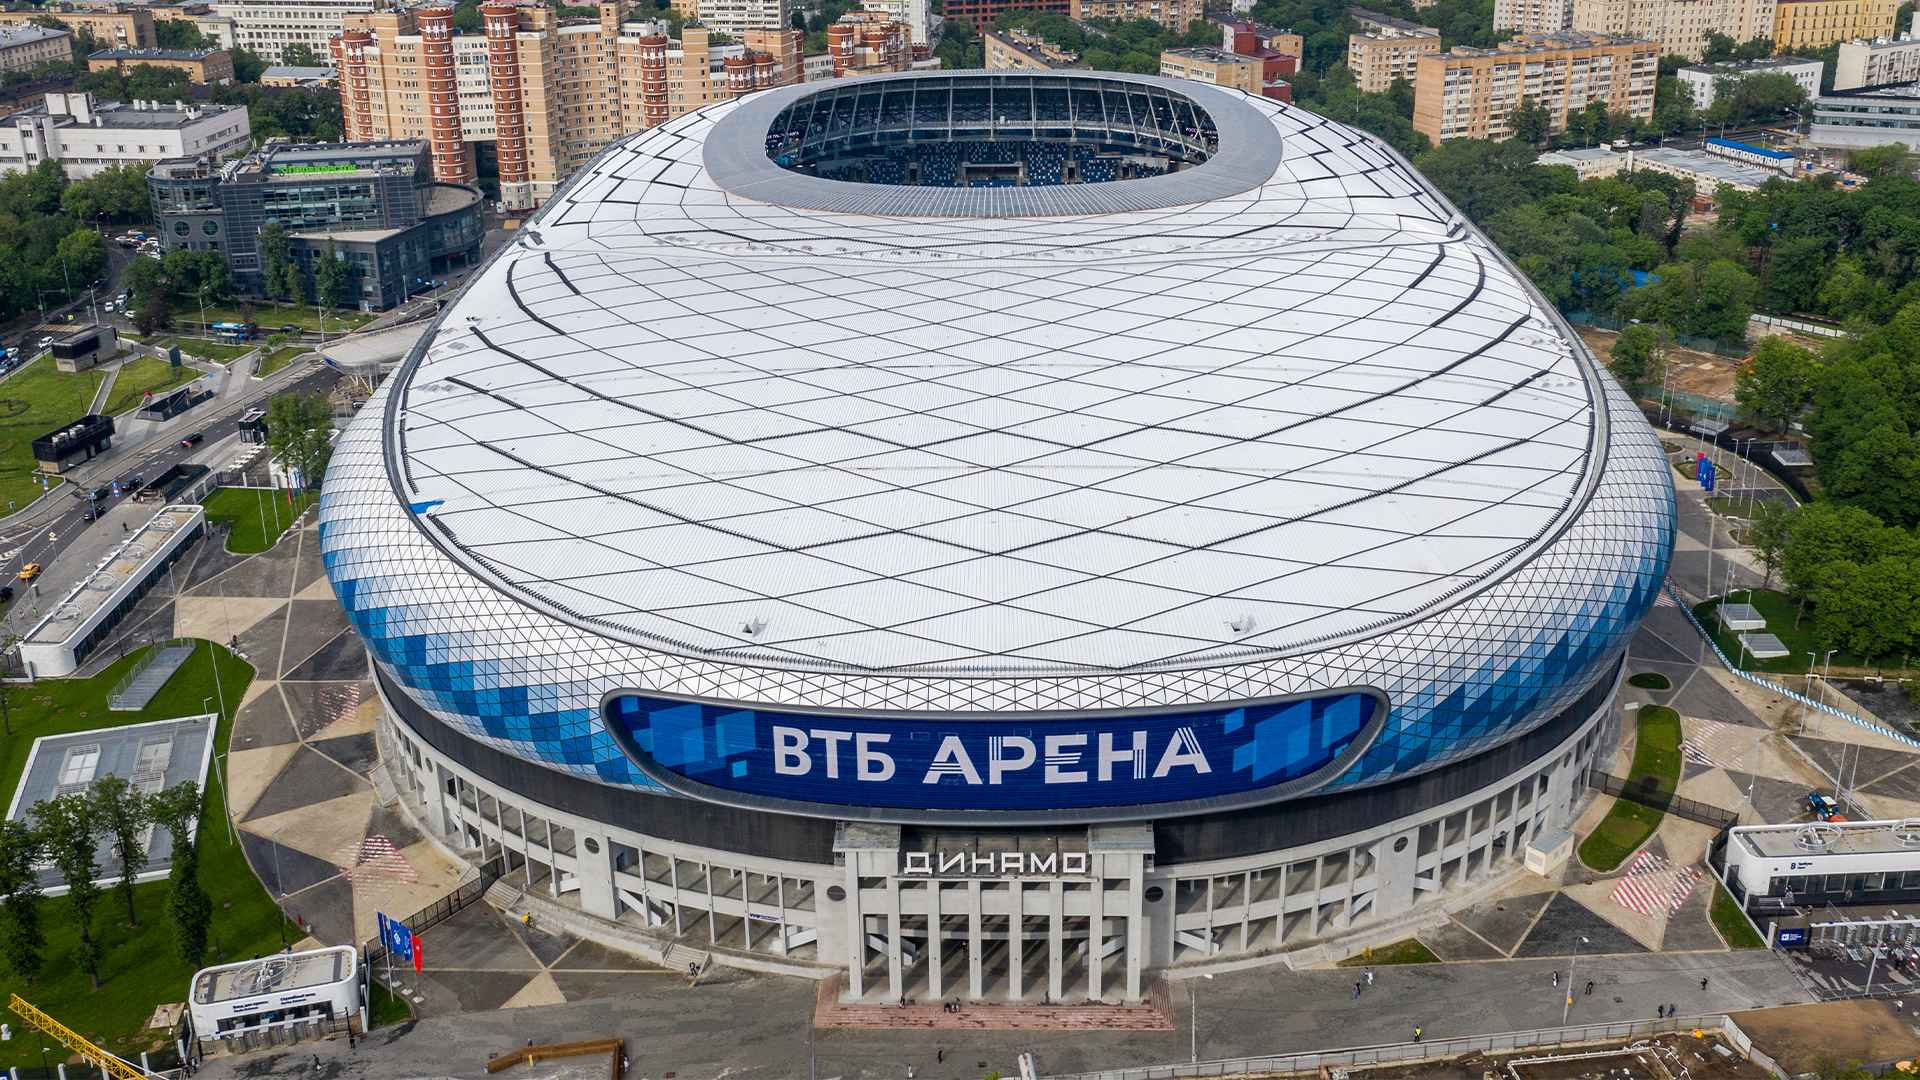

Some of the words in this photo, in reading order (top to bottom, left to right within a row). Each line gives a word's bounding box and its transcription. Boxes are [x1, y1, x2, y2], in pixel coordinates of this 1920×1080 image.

[773, 725, 897, 783] ВТБ
[922, 727, 1213, 785] АРЕНА
[903, 851, 1087, 875] ДИНАМО
